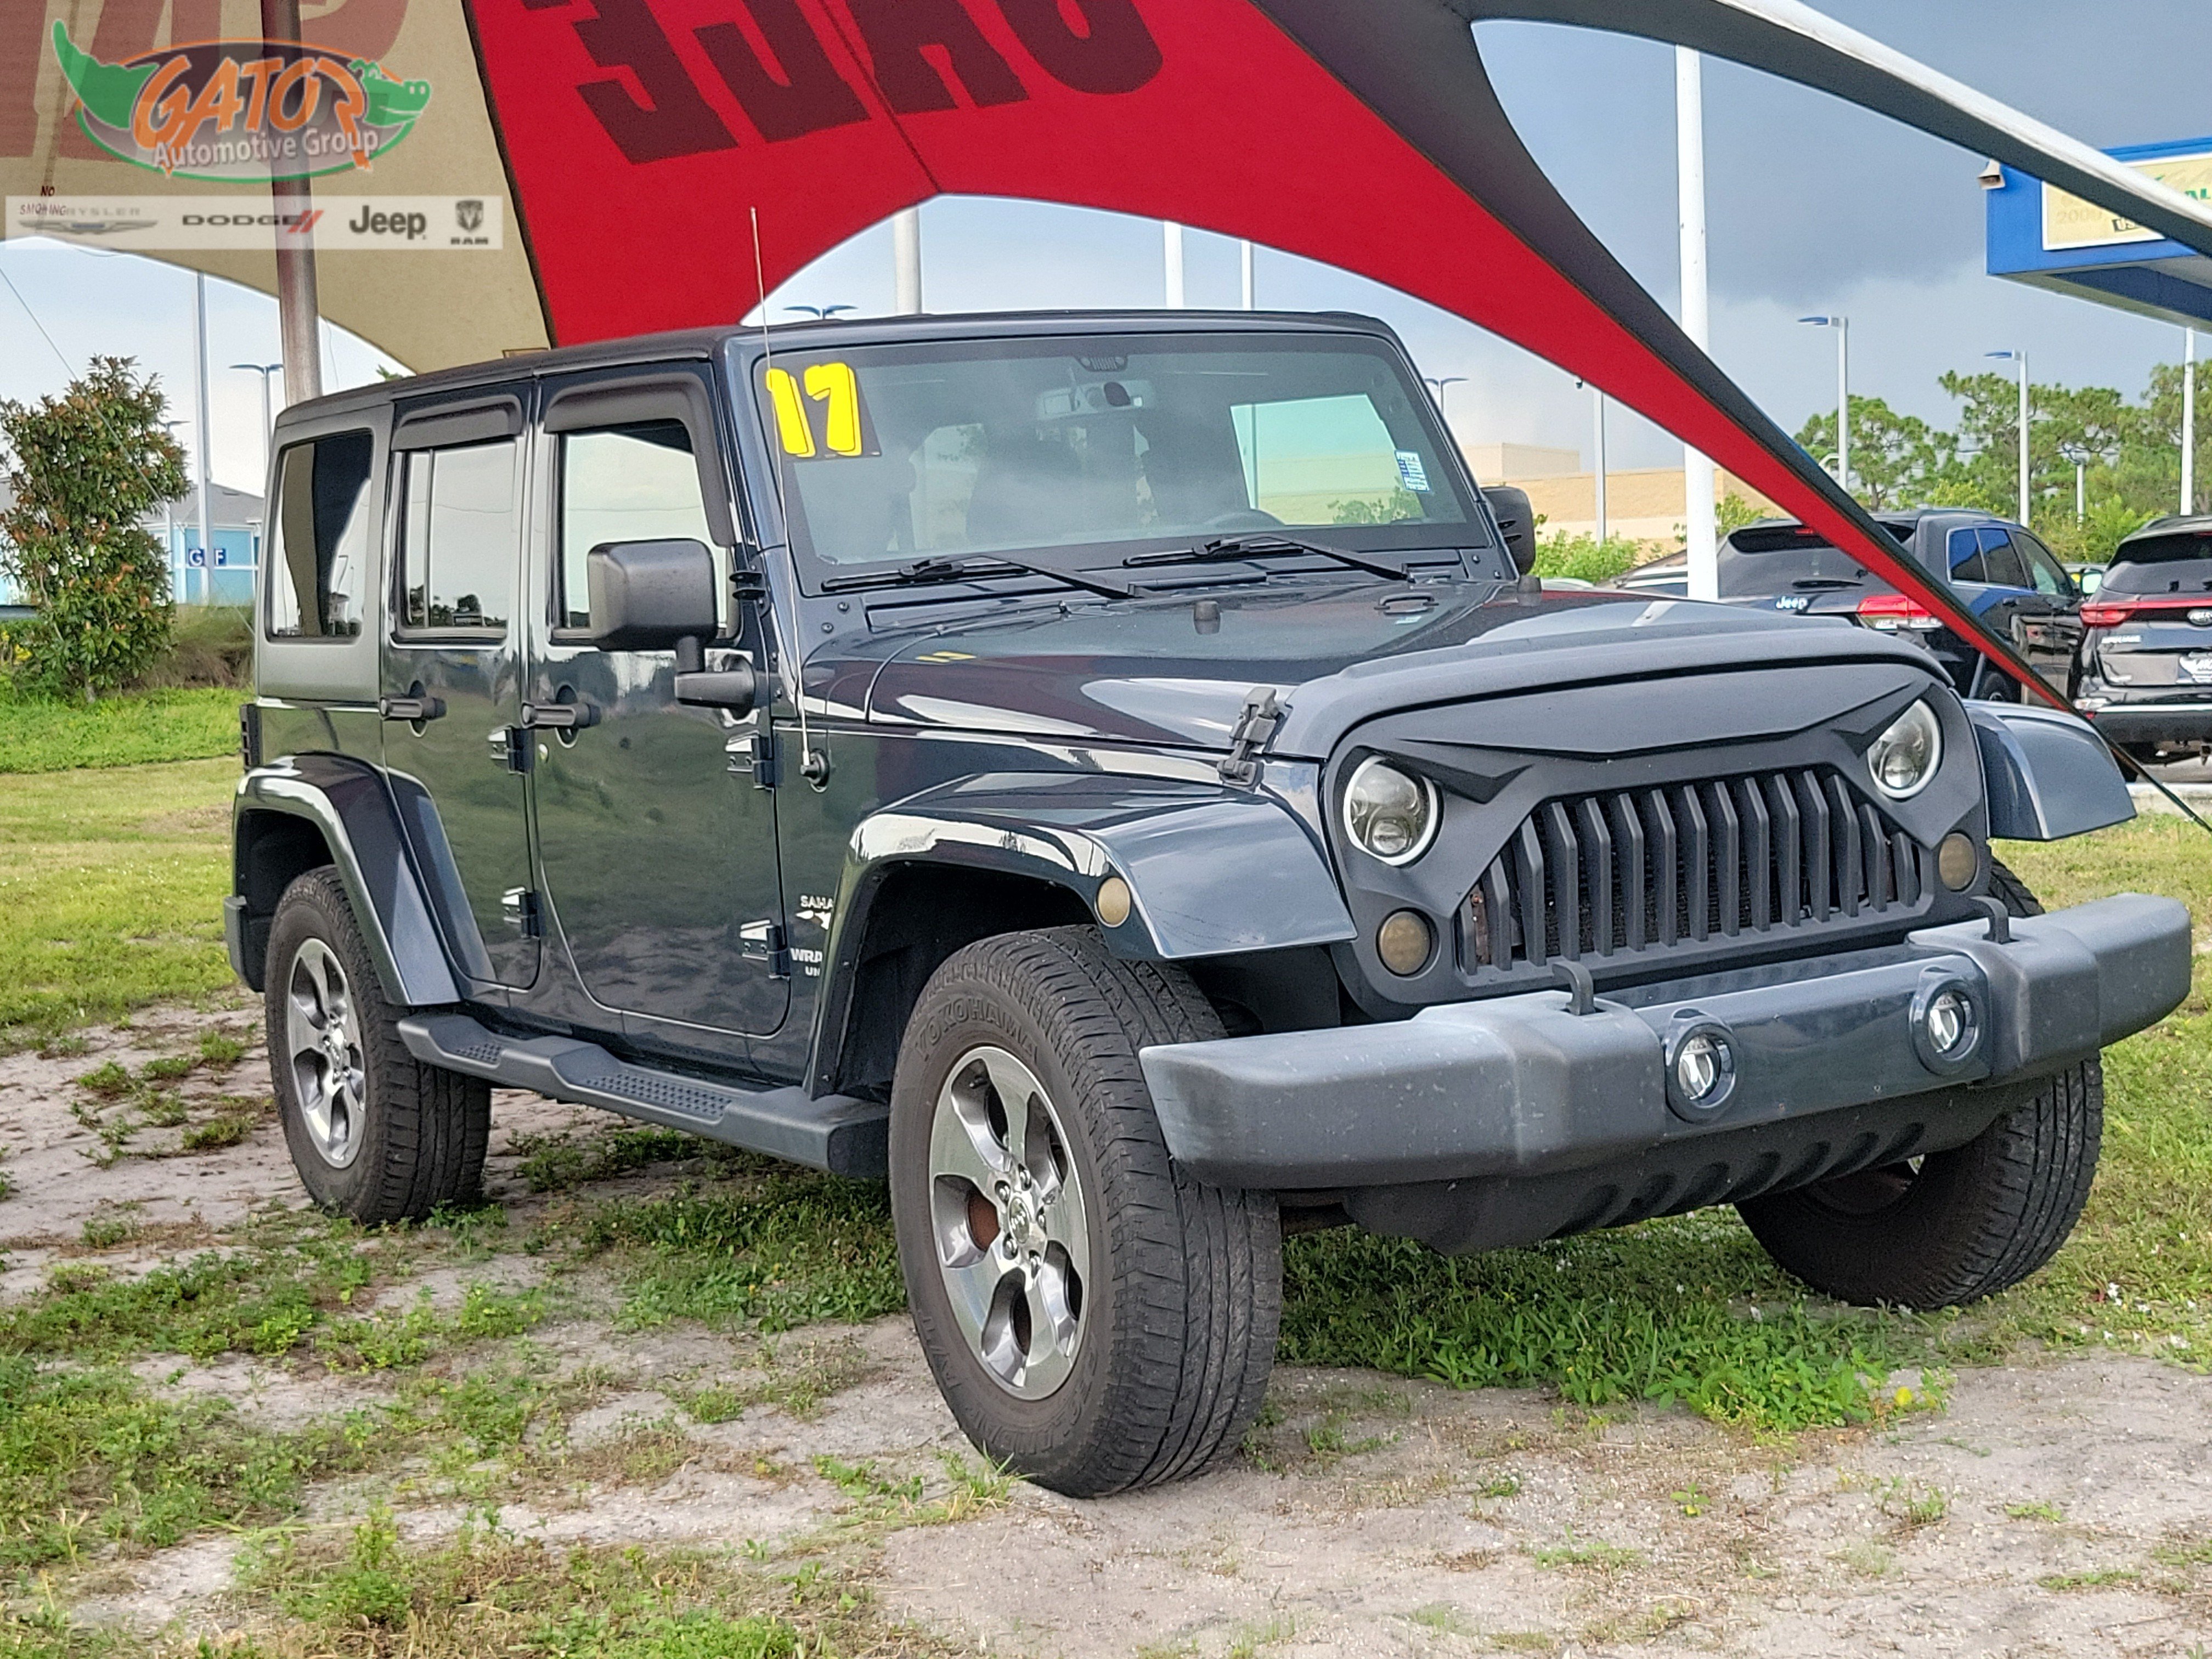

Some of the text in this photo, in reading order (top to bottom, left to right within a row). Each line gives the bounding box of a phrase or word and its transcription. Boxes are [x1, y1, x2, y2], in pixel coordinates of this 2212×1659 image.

[41, 185, 55, 196] NO
[766, 363, 862, 458] 17
[1776, 596, 1808, 610] Jeep
[915, 997, 1038, 1064] YOKOHAMA
